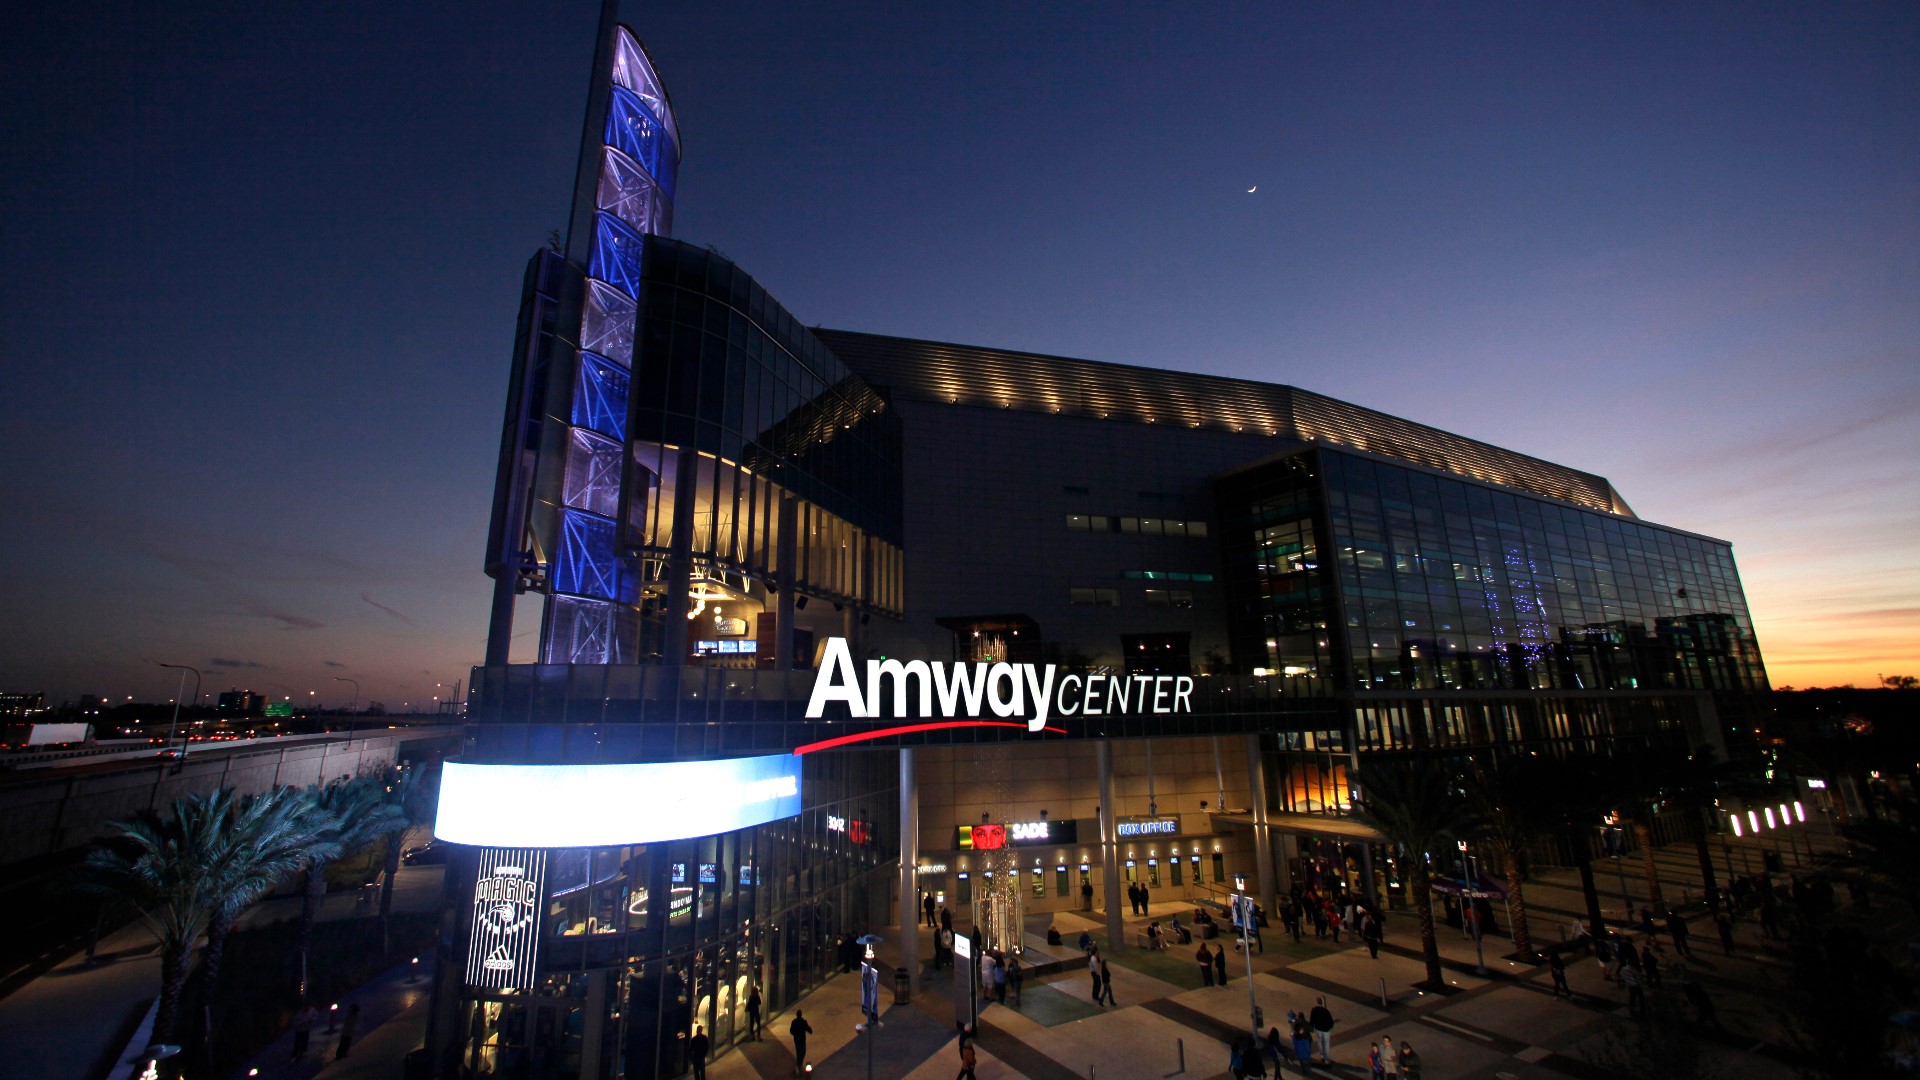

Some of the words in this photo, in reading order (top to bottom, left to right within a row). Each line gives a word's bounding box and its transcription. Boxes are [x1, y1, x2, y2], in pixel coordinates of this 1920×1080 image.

[805, 637, 1056, 732] Amway
[1057, 674, 1194, 715] CENTER
[1012, 822, 1049, 839] SADE
[1118, 824, 1140, 836] BOX
[1141, 821, 1176, 834] OFFICE
[475, 877, 536, 906] MAGIC
[485, 959, 513, 969] adidas
